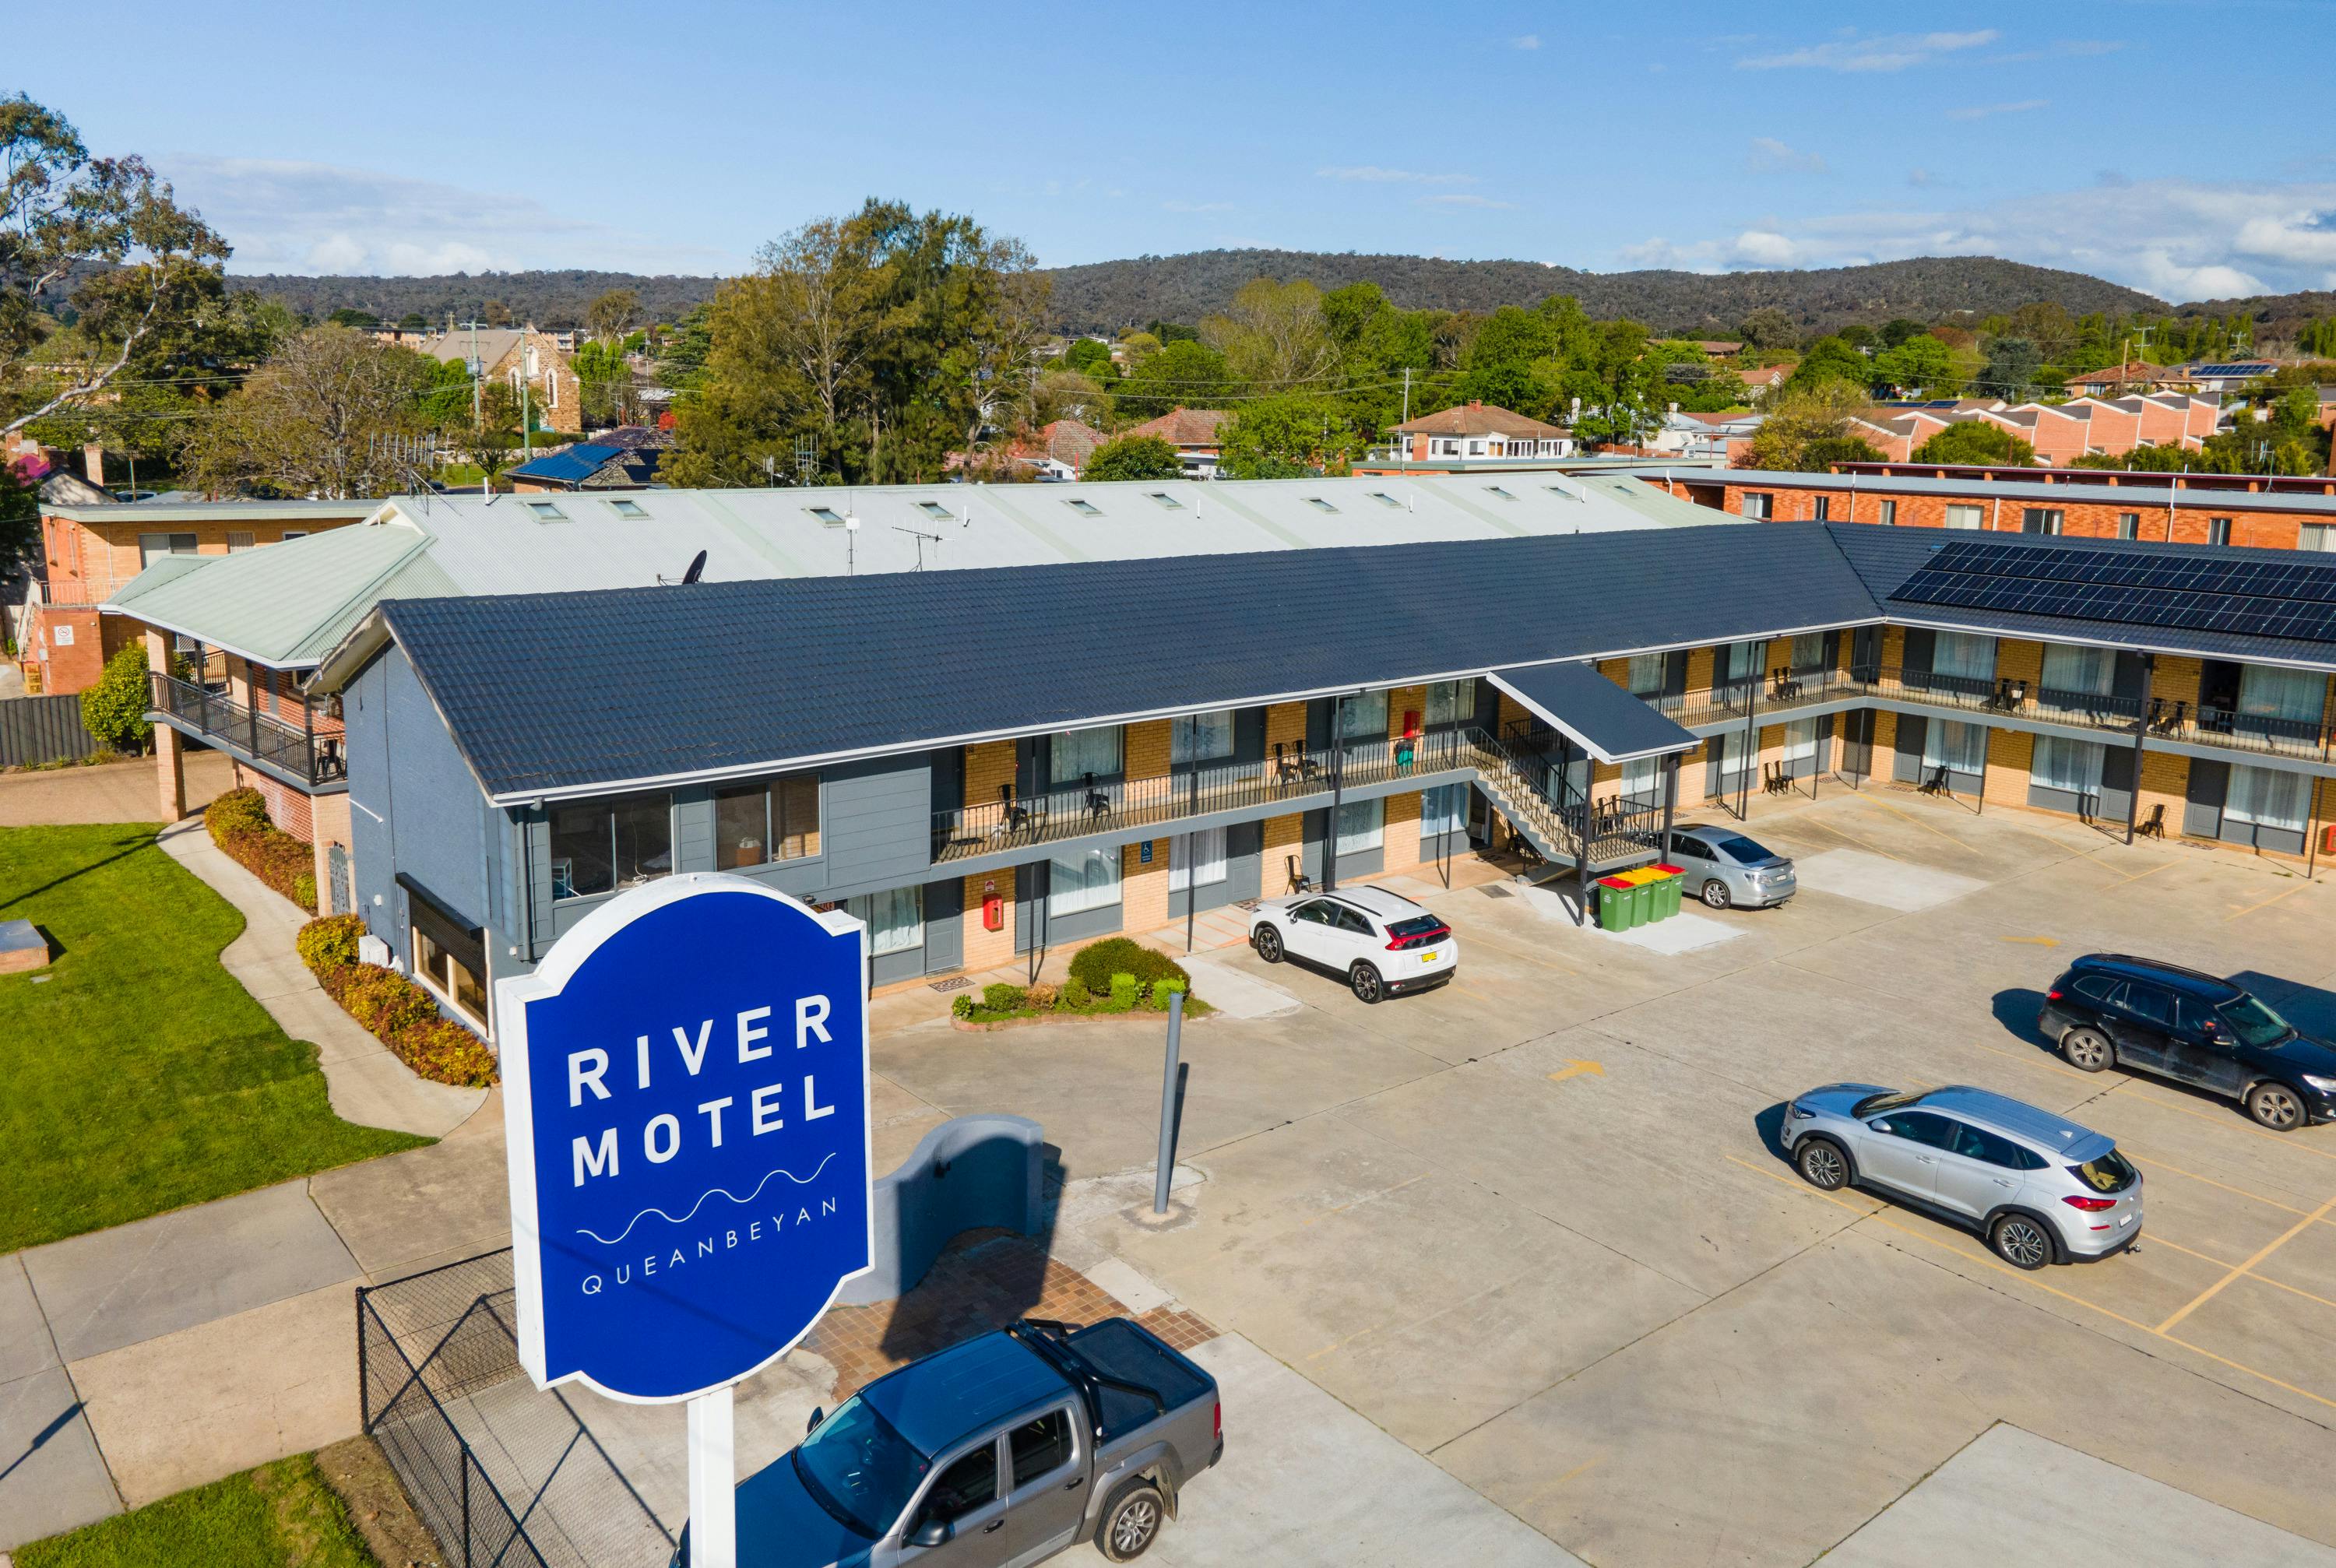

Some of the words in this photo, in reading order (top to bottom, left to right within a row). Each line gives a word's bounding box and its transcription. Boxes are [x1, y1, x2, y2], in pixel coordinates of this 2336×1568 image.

[568, 994, 833, 1107] RIVER
[572, 1074, 835, 1187] MOTEL
[582, 1197, 836, 1295] QUEANBEYAN
